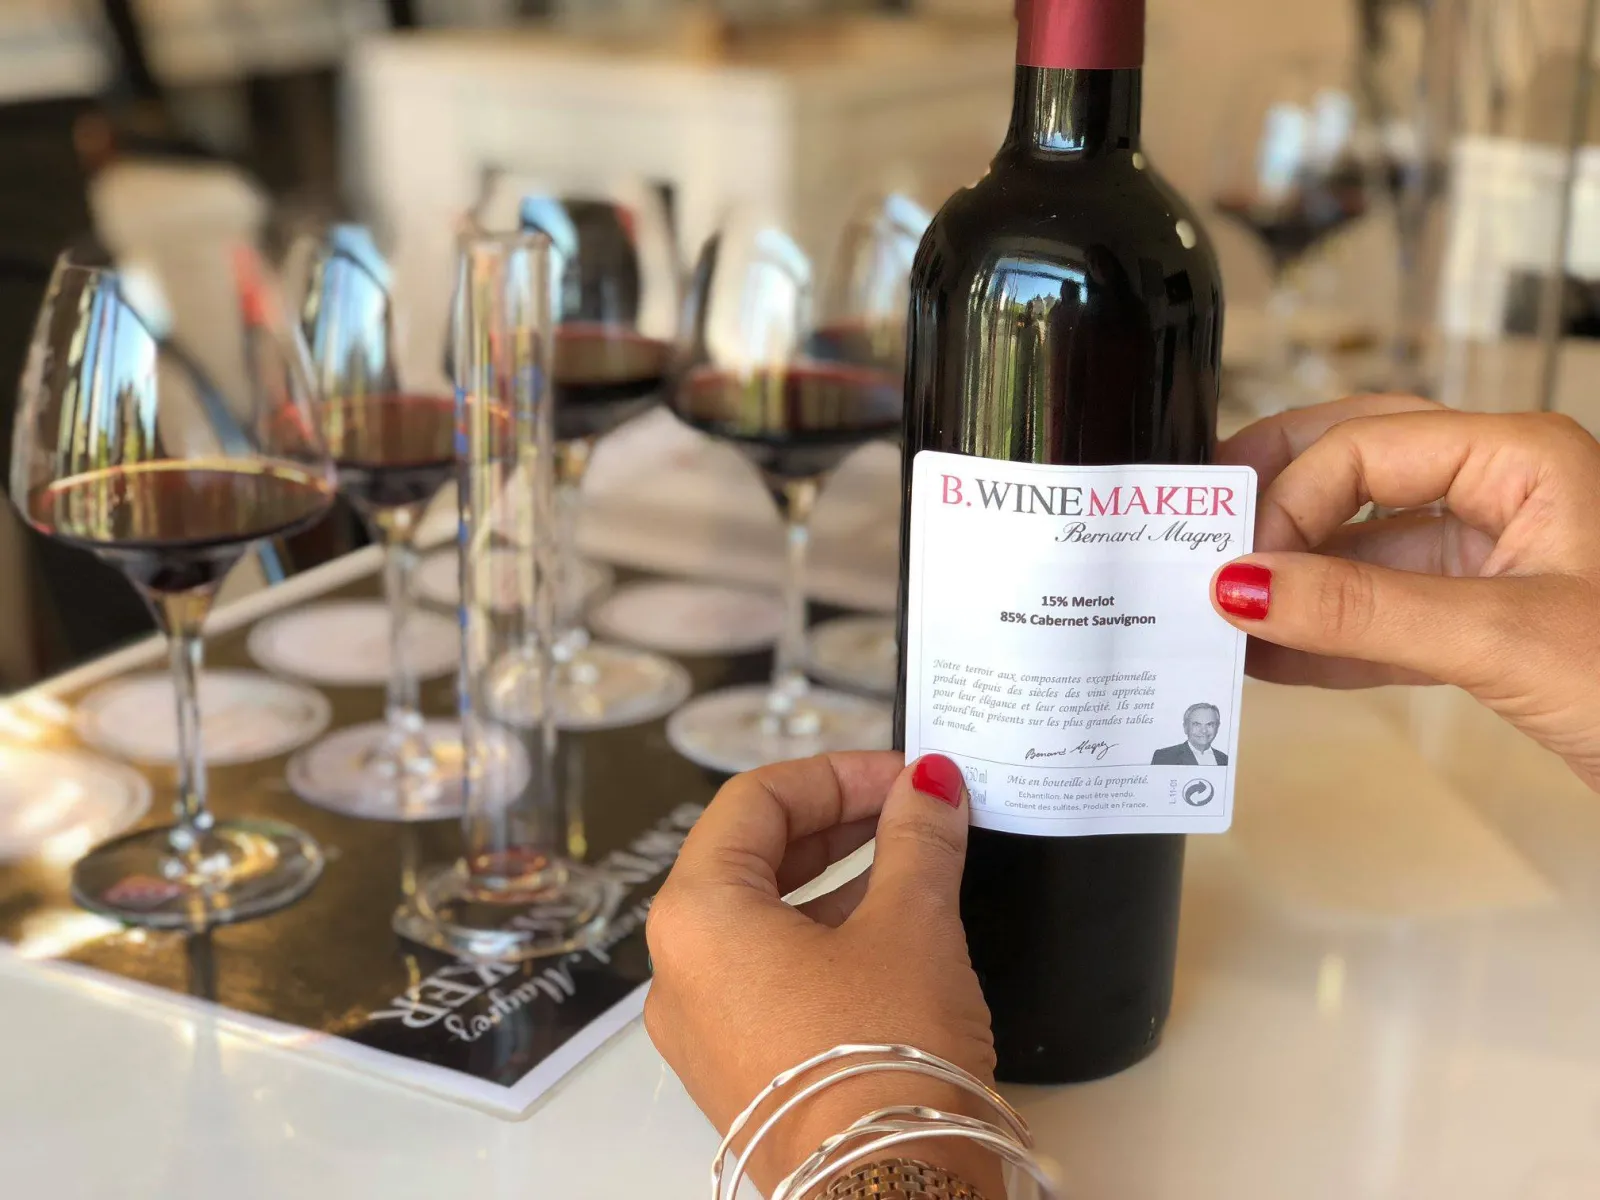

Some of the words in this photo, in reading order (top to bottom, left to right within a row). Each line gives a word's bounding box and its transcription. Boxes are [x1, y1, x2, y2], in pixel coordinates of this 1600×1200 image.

[1055, 521, 1147, 543] Bernard
[1148, 520, 1235, 552] Magrez
[1041, 596, 1068, 607] 15%
[1072, 595, 1115, 607] Merlot
[1000, 611, 1027, 624] 85%
[1030, 614, 1089, 627] Cabernet
[1092, 613, 1156, 627] Sauvignon
[933, 659, 960, 671] Notre
[965, 664, 994, 676] terroir
[998, 671, 1017, 682] aux
[1021, 674, 1081, 686] composantes
[1086, 670, 1157, 686] exceptionnelles
[932, 674, 967, 686] produit
[973, 679, 1002, 692] depuis
[1007, 685, 1023, 695] des
[1029, 687, 1059, 698] siècles
[1064, 688, 1080, 698] des
[1087, 687, 1106, 697] vins
[1112, 686, 1155, 699] appréciés
[932, 688, 955, 699] pour
[958, 690, 977, 702] leur
[979, 695, 1017, 709] élégance
[1021, 703, 1030, 711] et
[1036, 701, 1055, 712] leur
[1059, 702, 1111, 715] complexité.
[1117, 700, 1129, 710] Ils
[1133, 702, 1155, 710] sont
[932, 716, 945, 726] du
[987, 712, 1024, 723] présents
[1028, 718, 1044, 726] sur
[1047, 717, 1059, 727] les
[1062, 717, 1083, 729] plus
[1086, 715, 1122, 729] grandes
[1125, 714, 1154, 724] tables
[1007, 775, 1026, 785] Mis
[1043, 777, 1084, 788] bouteille
[1086, 777, 1092, 787] à
[1094, 776, 1102, 786] la
[1104, 775, 1148, 788] propriété.
[1076, 792, 1092, 802] peut
[1094, 791, 1109, 799] être
[1111, 790, 1135, 799] vendu.
[1005, 801, 1036, 809] Contient
[1038, 803, 1051, 811] des
[1083, 802, 1109, 810] Produit
[1122, 801, 1148, 809] France.
